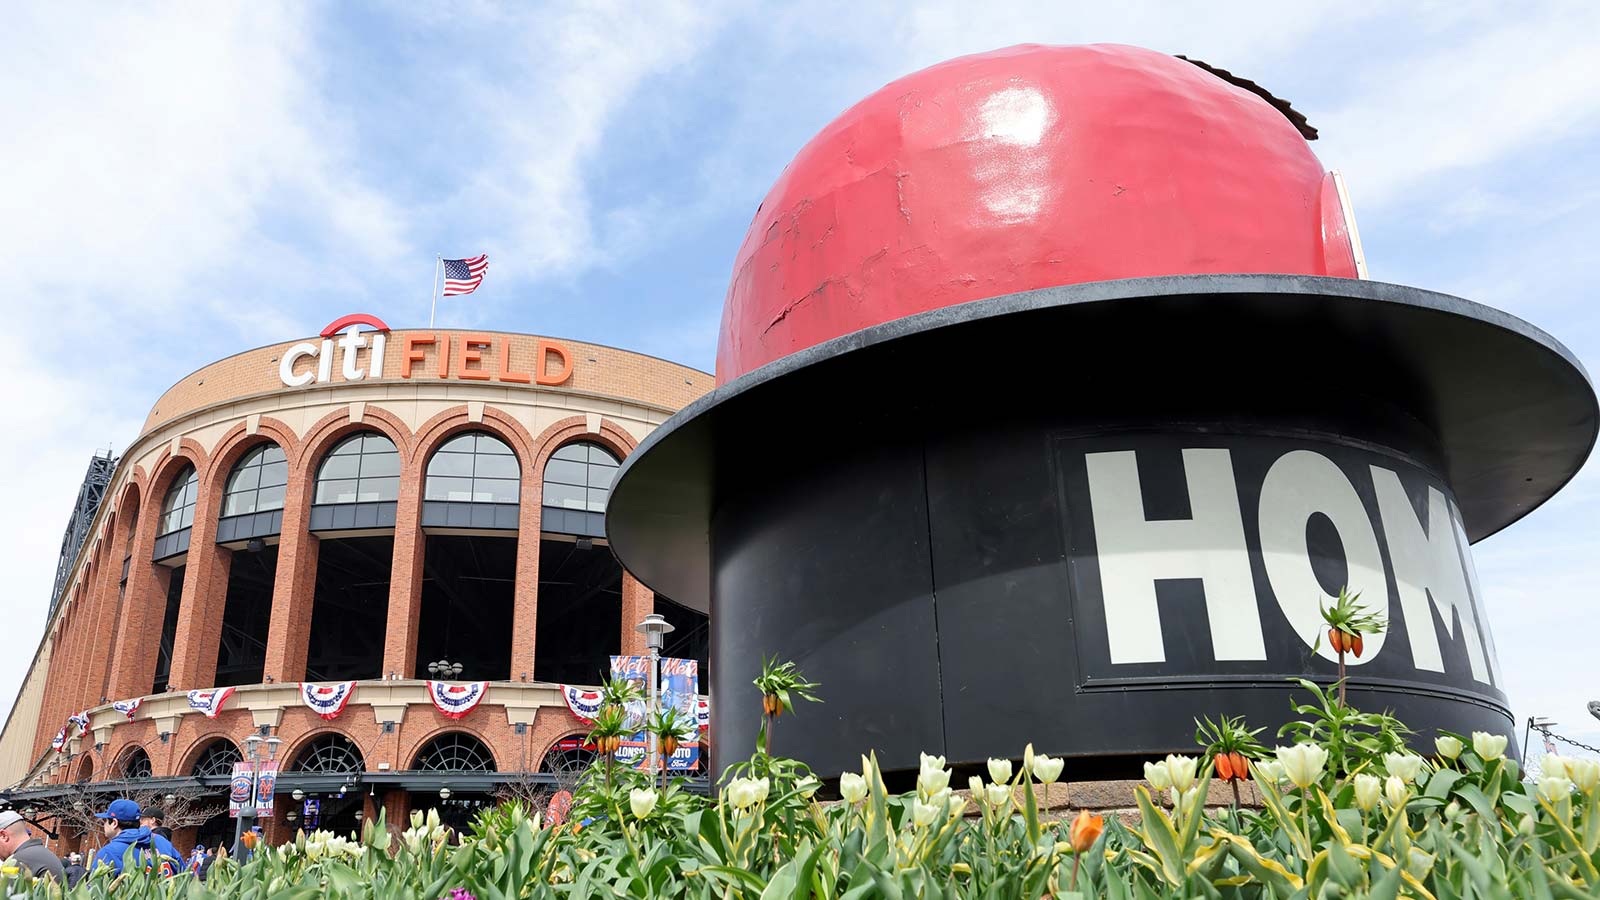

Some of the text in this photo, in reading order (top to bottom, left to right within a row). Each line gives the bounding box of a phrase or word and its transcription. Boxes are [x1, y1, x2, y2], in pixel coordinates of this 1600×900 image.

[279, 316, 574, 387] citi FIELD
[1085, 448, 1502, 689] HOM
